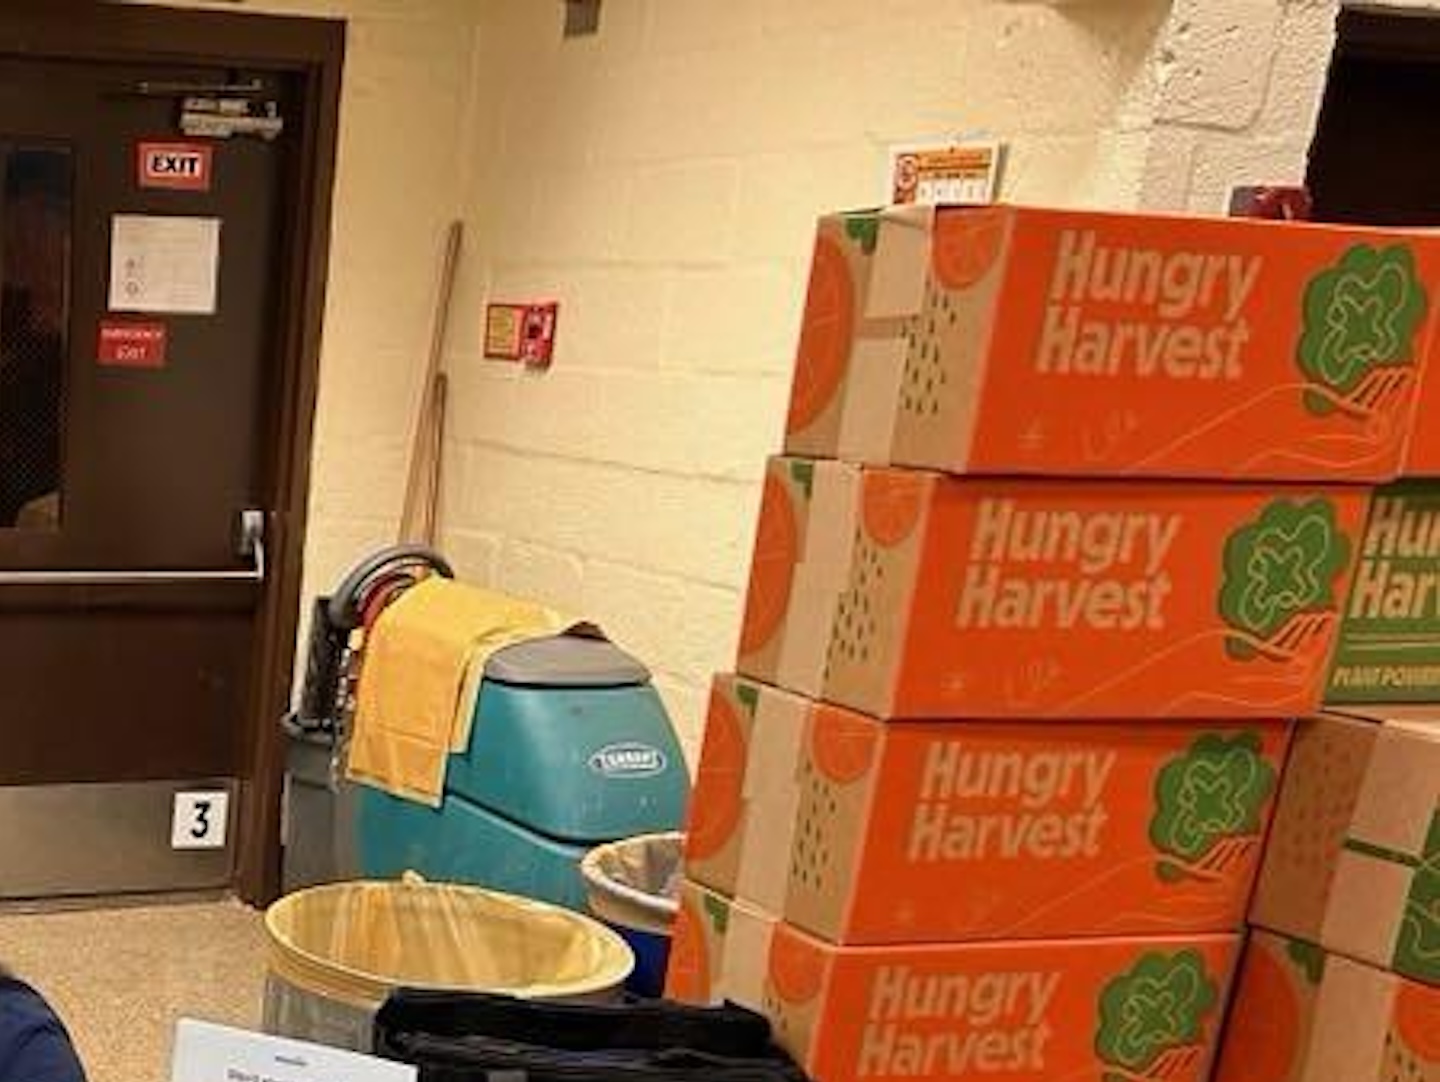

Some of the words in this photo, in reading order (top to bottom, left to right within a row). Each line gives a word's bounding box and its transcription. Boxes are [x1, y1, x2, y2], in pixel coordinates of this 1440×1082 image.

[152, 155, 200, 175] EXIT
[1050, 229, 1263, 322] Hungry
[1036, 306, 1250, 380] Harvest
[970, 498, 1182, 576] Hungry
[956, 564, 1172, 630] Harvest
[1349, 559, 1440, 620] Har
[919, 741, 1117, 809] Hungry
[191, 801, 211, 838] 3
[907, 803, 1107, 860] Harvest
[868, 965, 1063, 1025] Hungry
[856, 1022, 1053, 1076] Harvest
